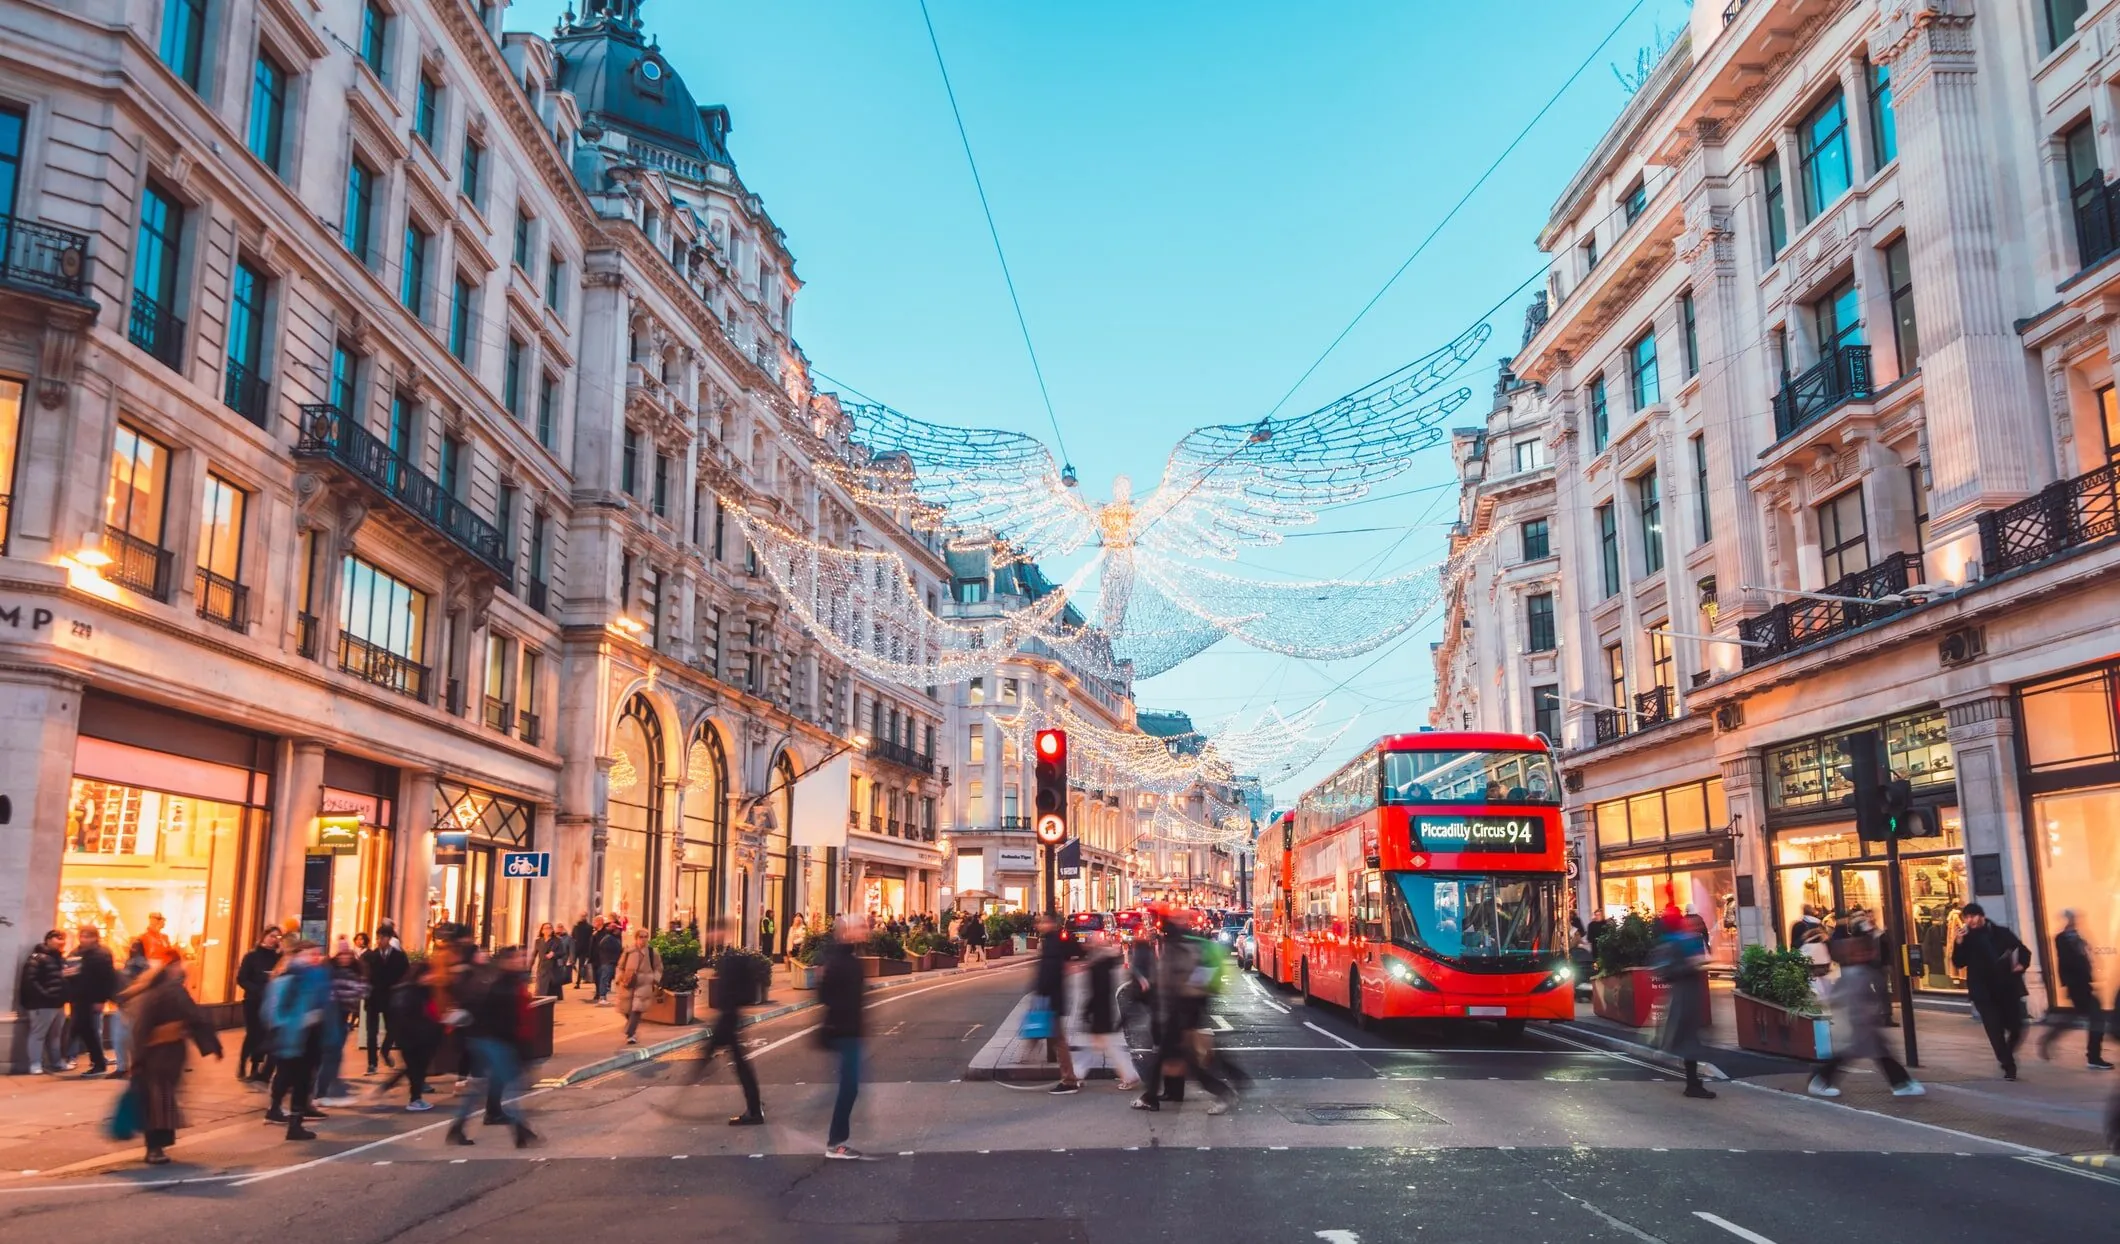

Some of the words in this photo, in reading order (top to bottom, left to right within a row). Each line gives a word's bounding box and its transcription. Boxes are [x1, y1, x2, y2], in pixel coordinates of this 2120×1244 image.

[1421, 822, 1471, 841] Piccadilly
[1472, 823, 1506, 838] Circus
[1506, 821, 1532, 843] 94
